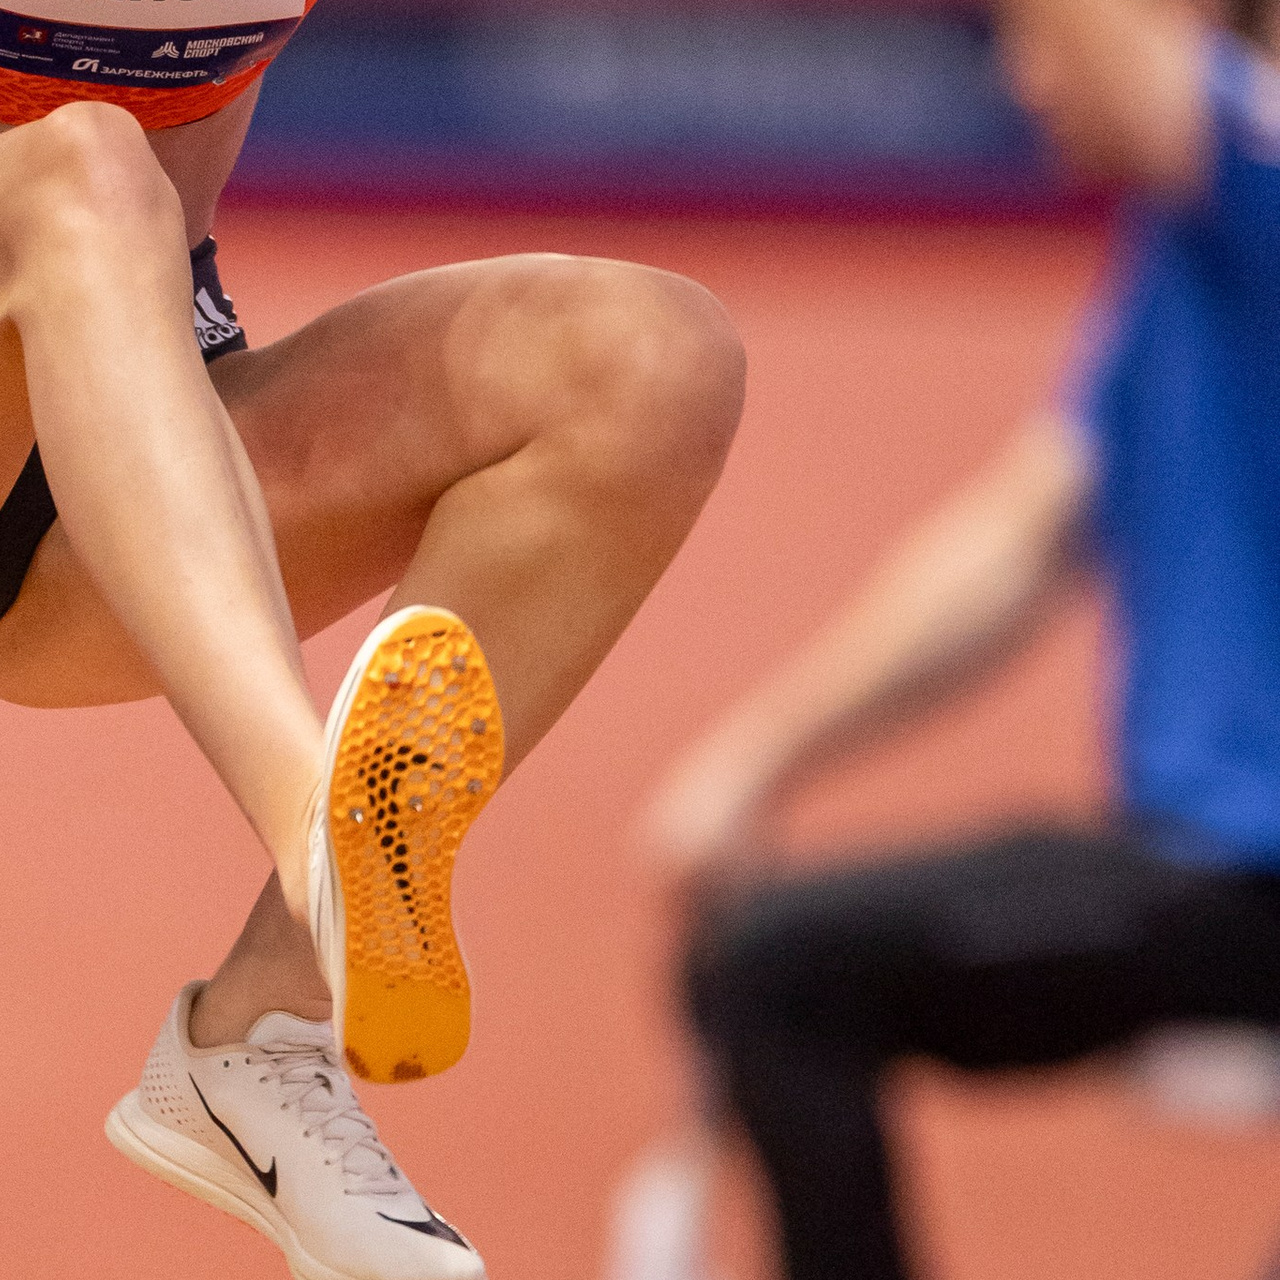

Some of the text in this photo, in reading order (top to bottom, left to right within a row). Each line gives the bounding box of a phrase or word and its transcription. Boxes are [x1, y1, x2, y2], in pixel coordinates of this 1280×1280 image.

[186, 32, 265, 50] МОСКОВСКИЙ
[183, 48, 222, 59] СПОРТ
[100, 66, 209, 79] ЗАРУБЕЖНЕФТЬ
